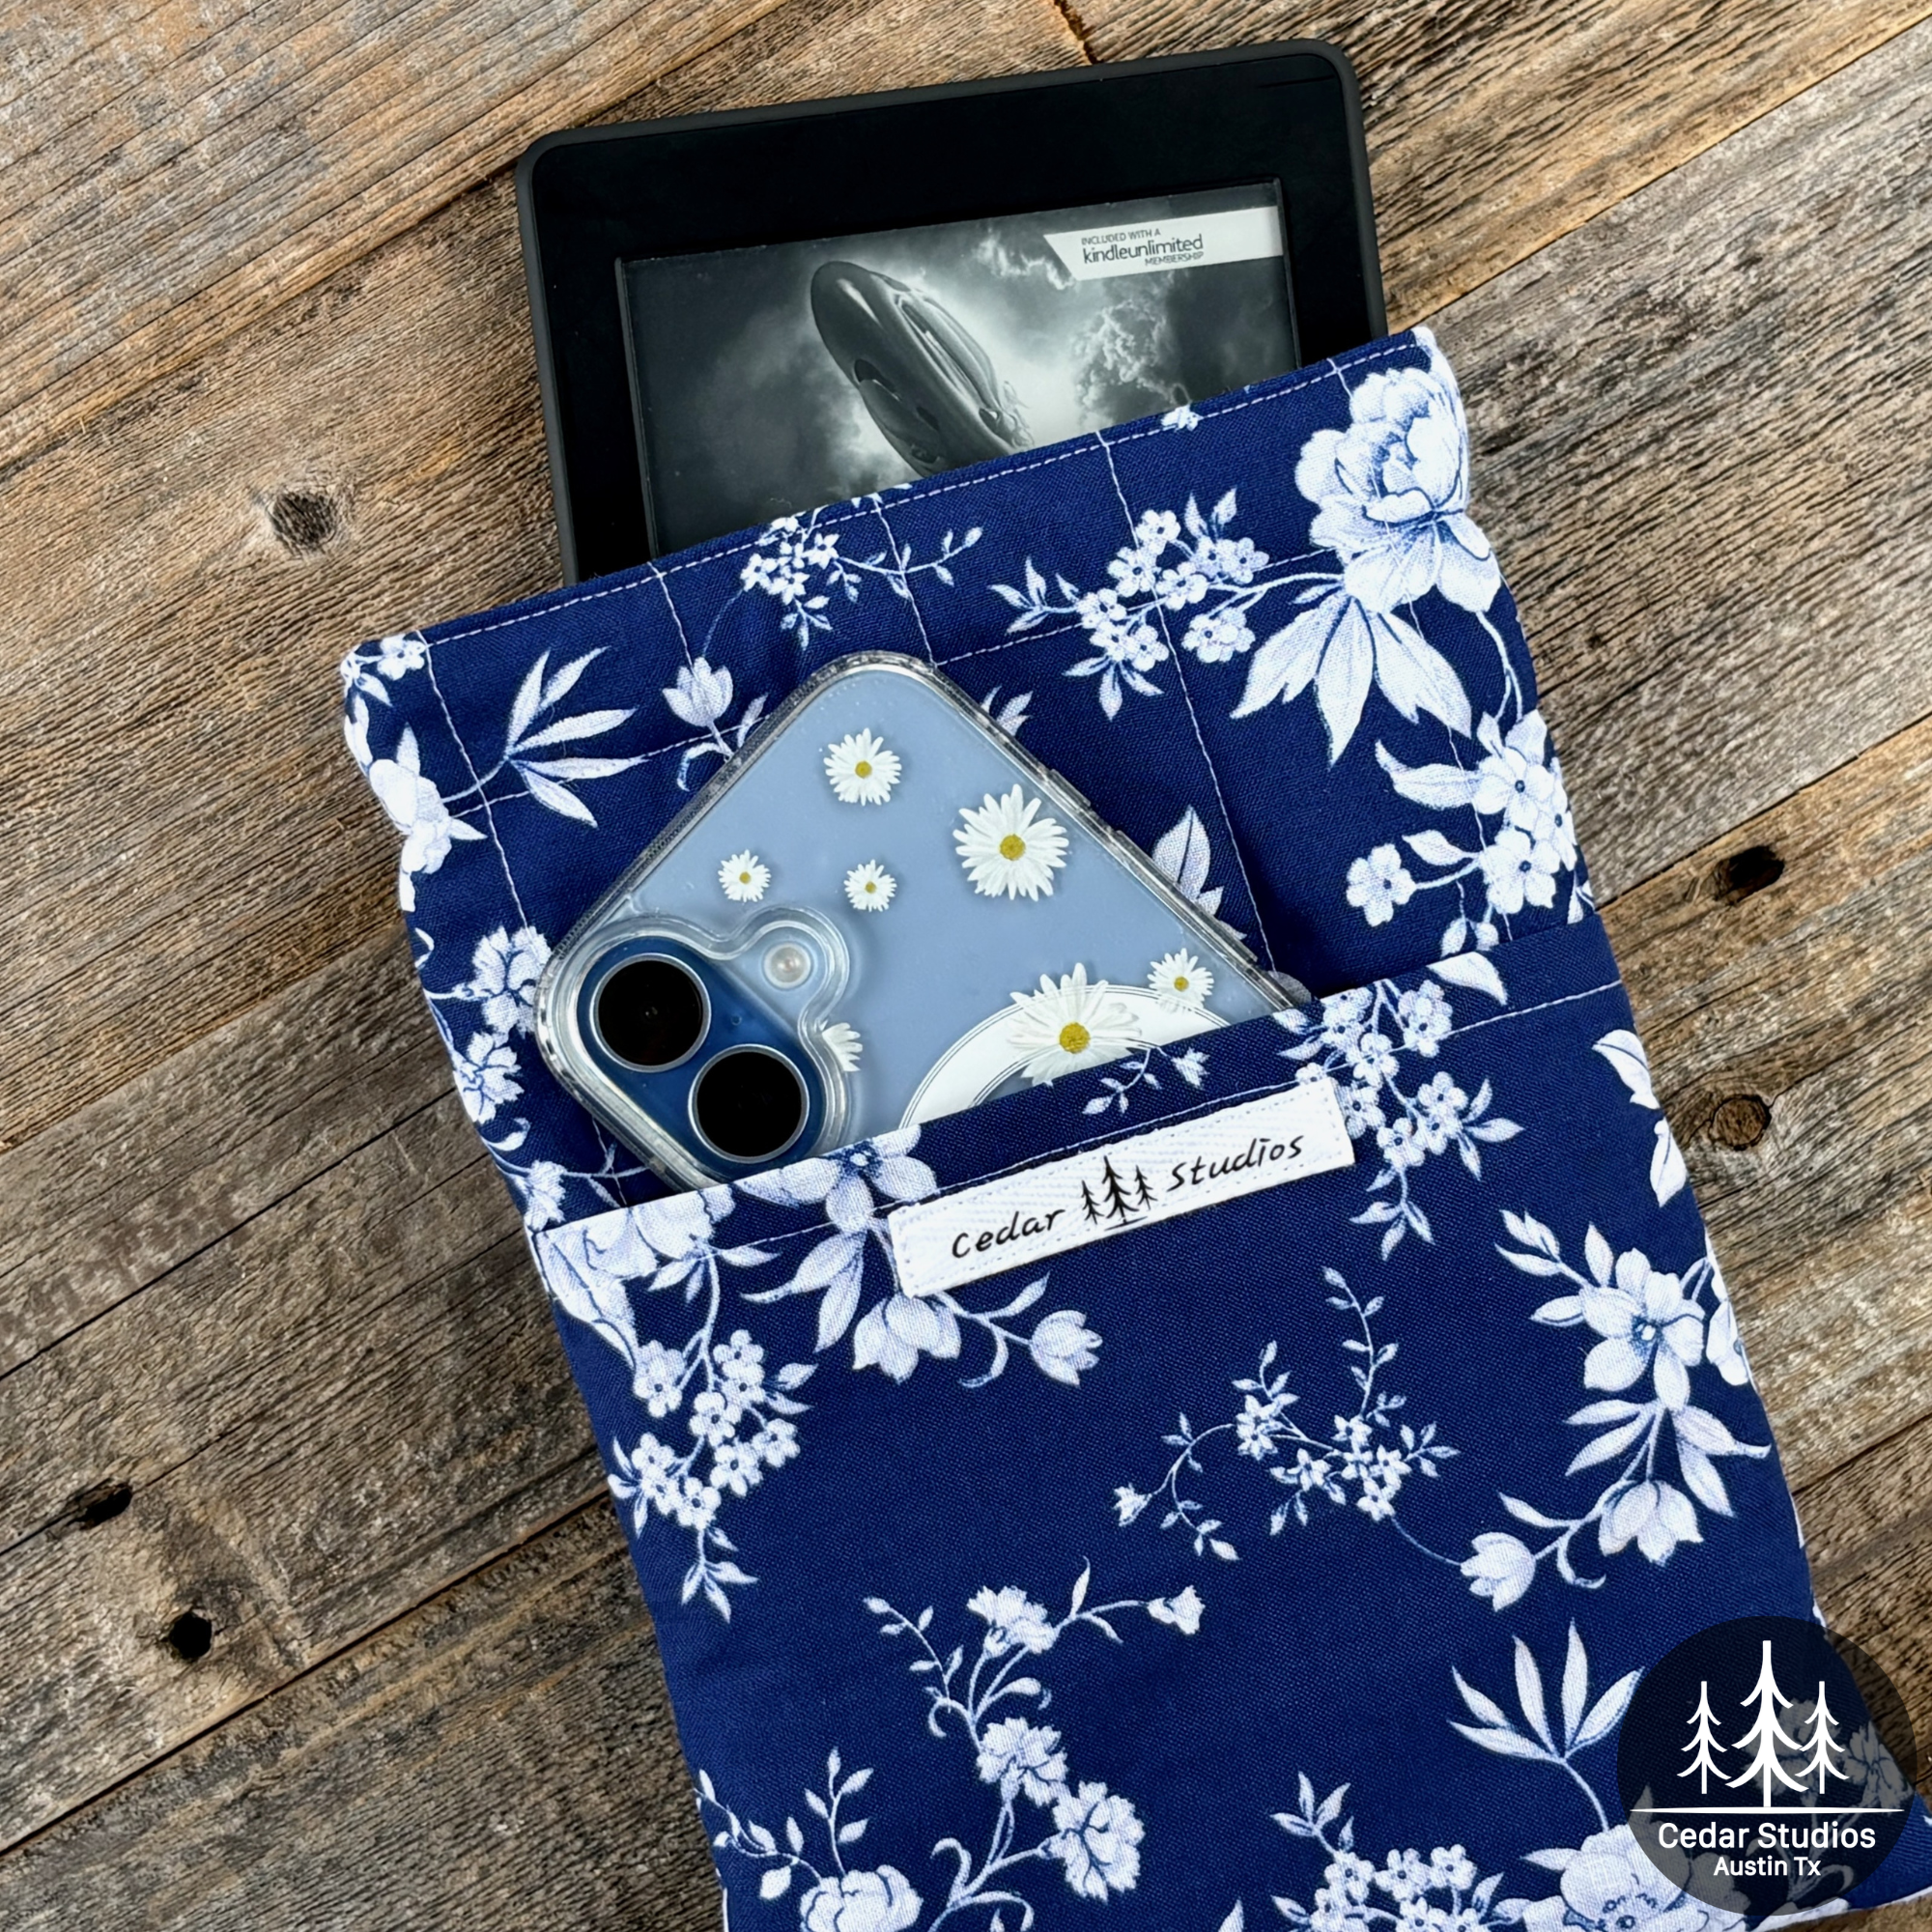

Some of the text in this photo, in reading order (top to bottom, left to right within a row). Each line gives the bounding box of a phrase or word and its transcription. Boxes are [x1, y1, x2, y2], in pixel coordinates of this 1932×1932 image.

[1081, 228, 1161, 245] INCLUDED WITH A
[1083, 233, 1204, 264] kindleunlimited
[1145, 251, 1204, 267] MEMBERSHIP
